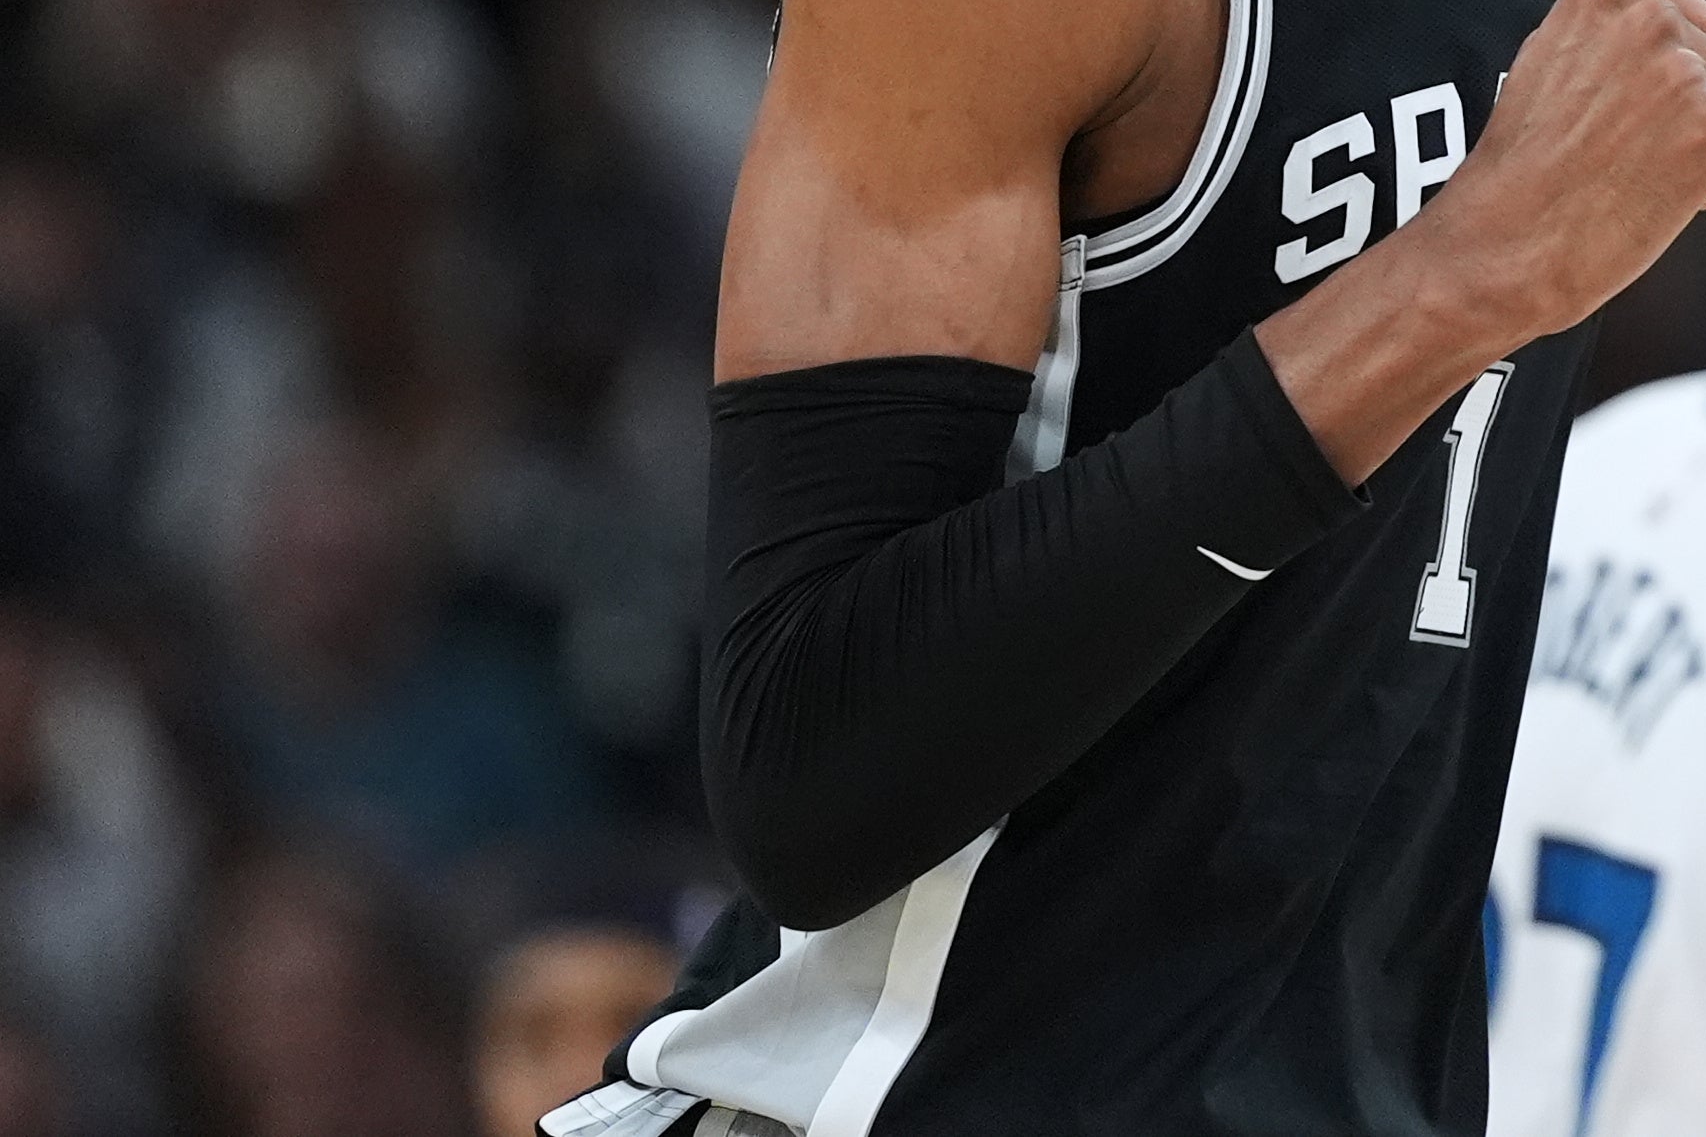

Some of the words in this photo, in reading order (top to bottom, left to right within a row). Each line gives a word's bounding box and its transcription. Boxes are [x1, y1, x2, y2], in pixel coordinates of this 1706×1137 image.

[1274, 72, 1508, 284] SP
[1409, 360, 1515, 648] 1
[1482, 833, 1658, 1137] 7
